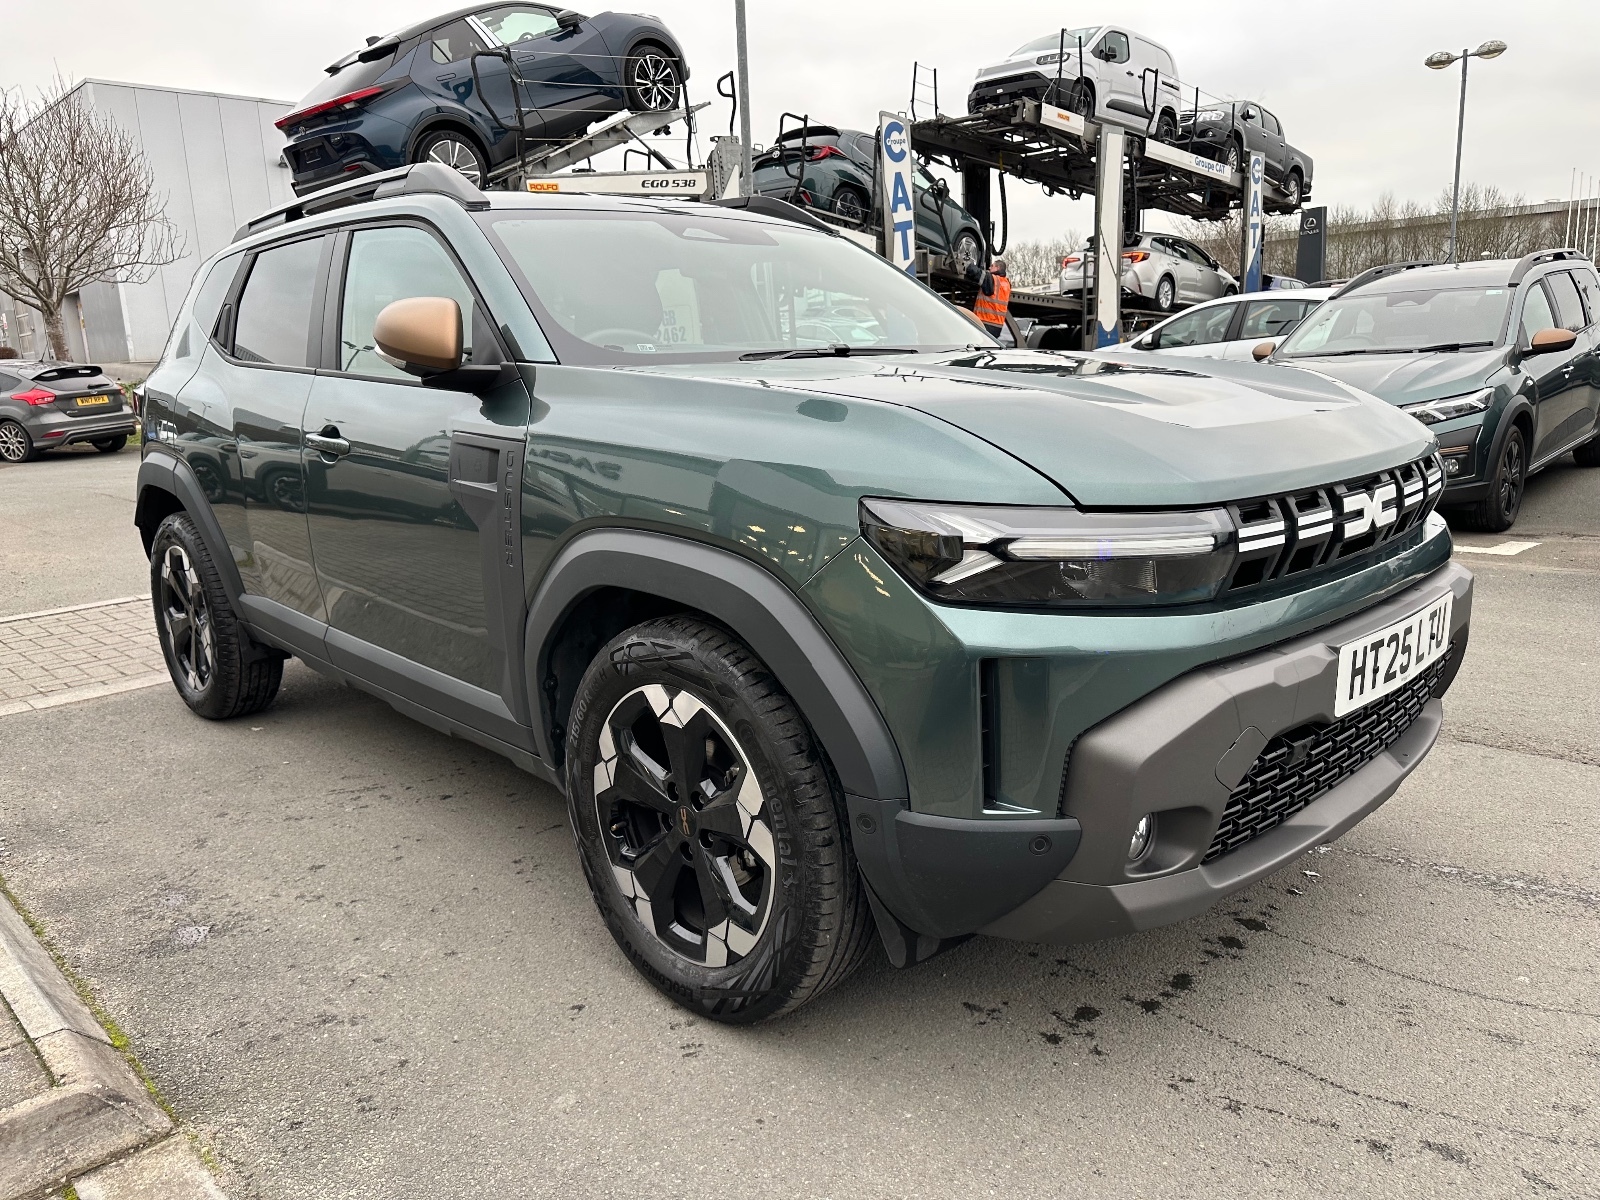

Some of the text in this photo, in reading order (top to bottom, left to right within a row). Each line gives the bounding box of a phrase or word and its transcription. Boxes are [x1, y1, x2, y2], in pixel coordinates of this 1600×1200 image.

[886, 137, 907, 149] Groupe
[1194, 156, 1226, 175] Groupe CAT
[529, 183, 558, 191] ROLFO
[641, 179, 696, 188] EGO 538
[884, 121, 913, 261] CAT
[1250, 158, 1261, 249] CAT
[504, 450, 515, 568] DUSTER
[1348, 602, 1447, 701] HT25 LTU
